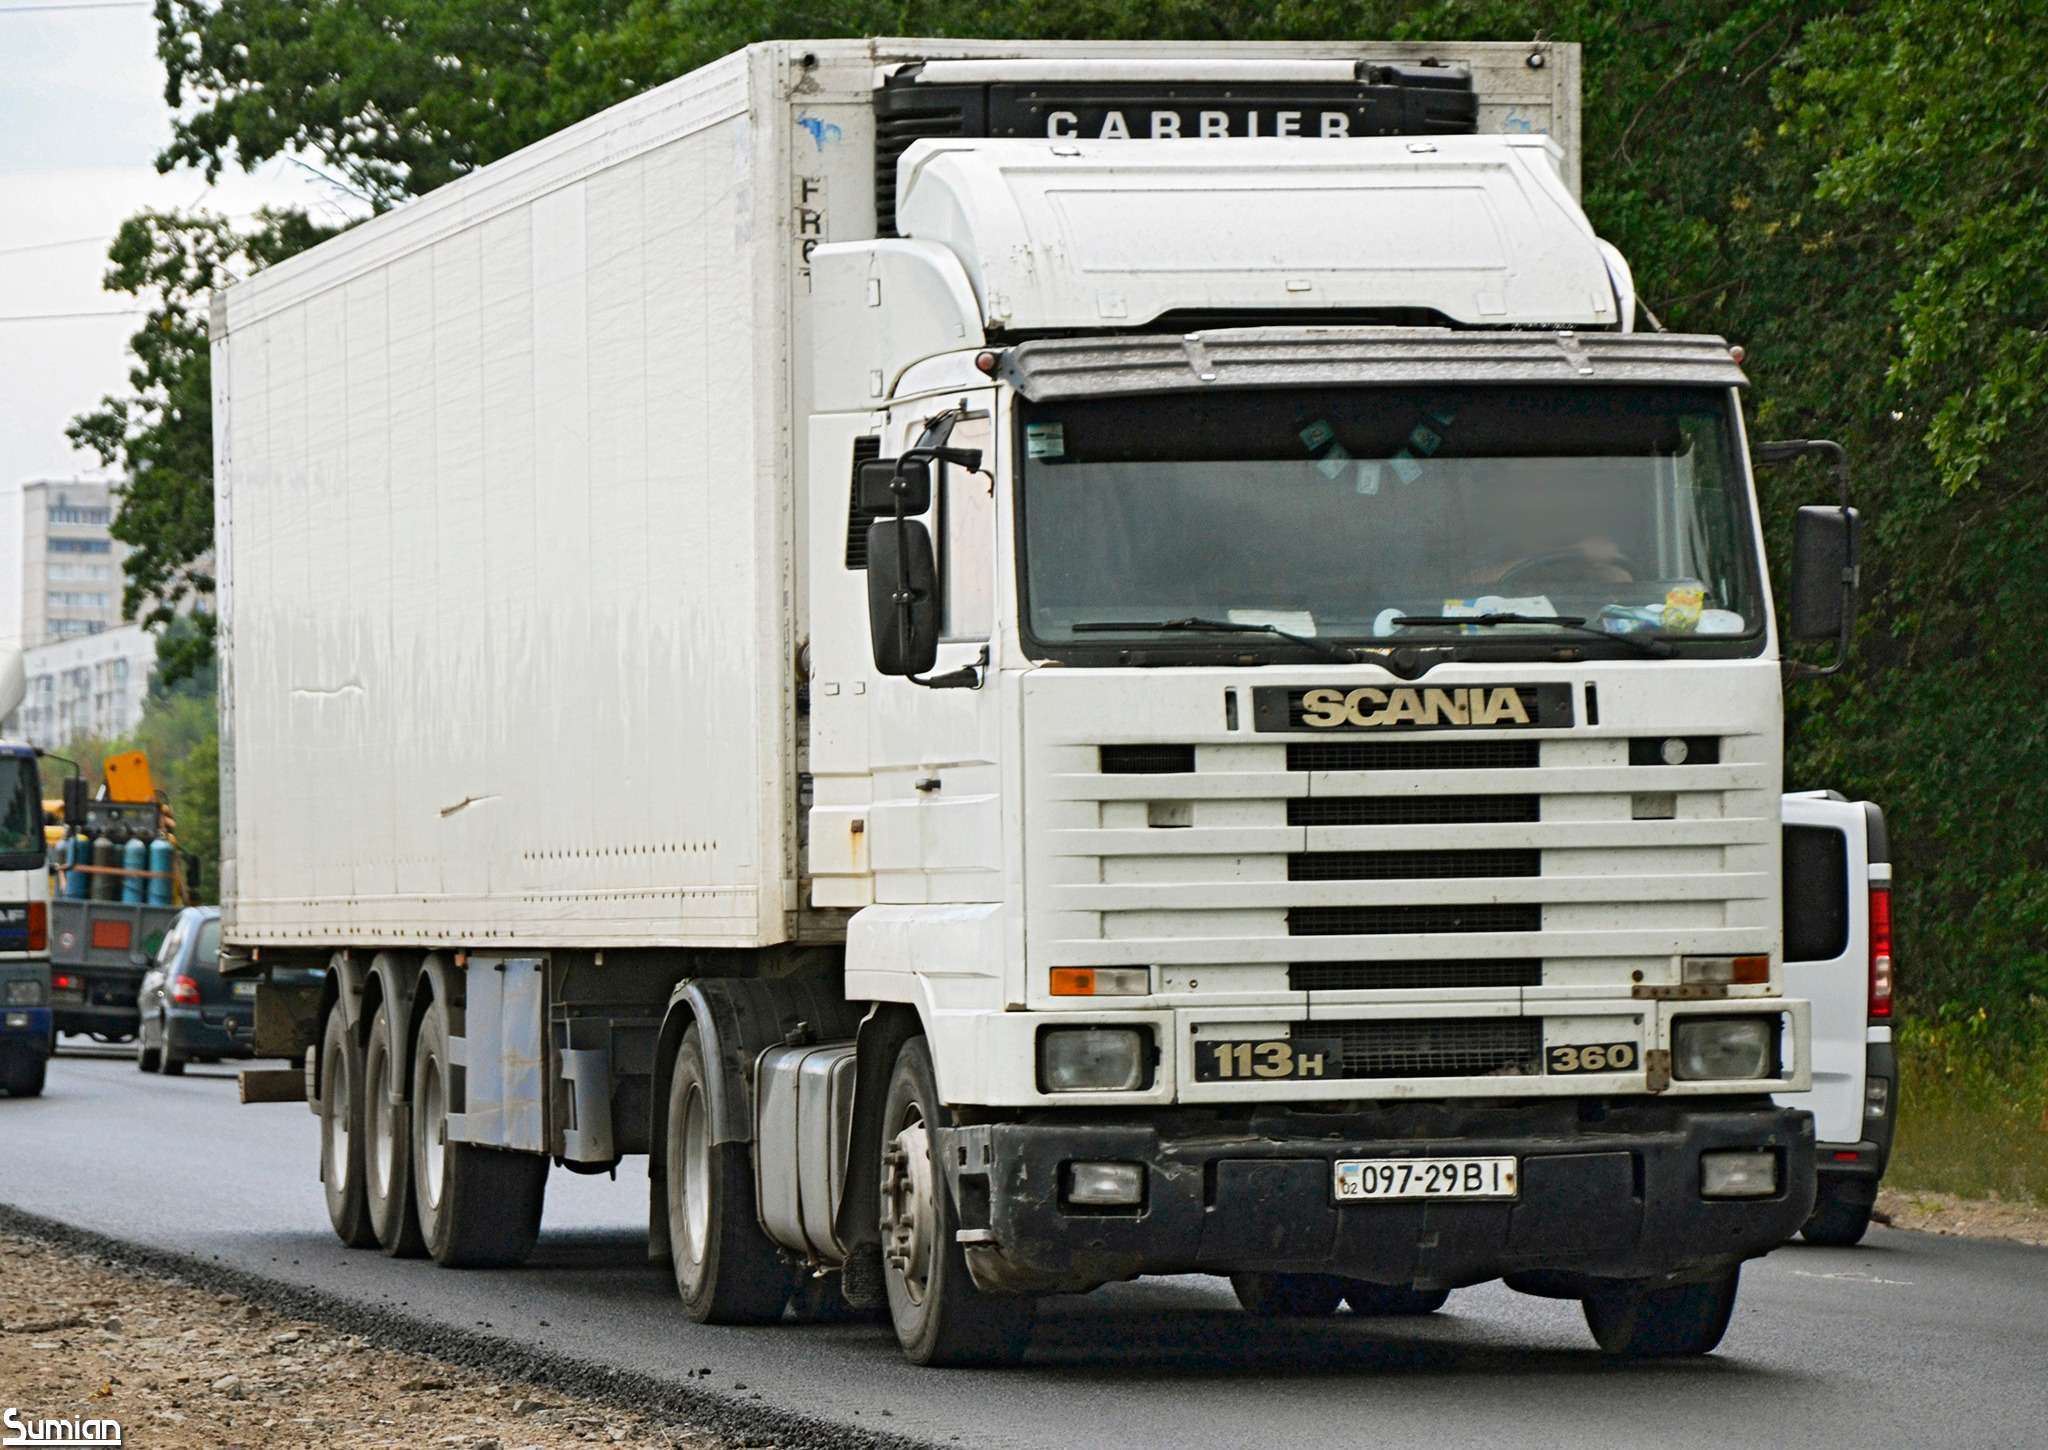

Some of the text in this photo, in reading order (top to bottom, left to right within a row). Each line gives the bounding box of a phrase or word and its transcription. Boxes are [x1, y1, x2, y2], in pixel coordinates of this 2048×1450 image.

[1047, 110, 1350, 139] CARRIER
[1302, 687, 1530, 727] SCANIA
[1551, 1044, 1634, 1072] 360
[1342, 1182, 1358, 1195] 02
